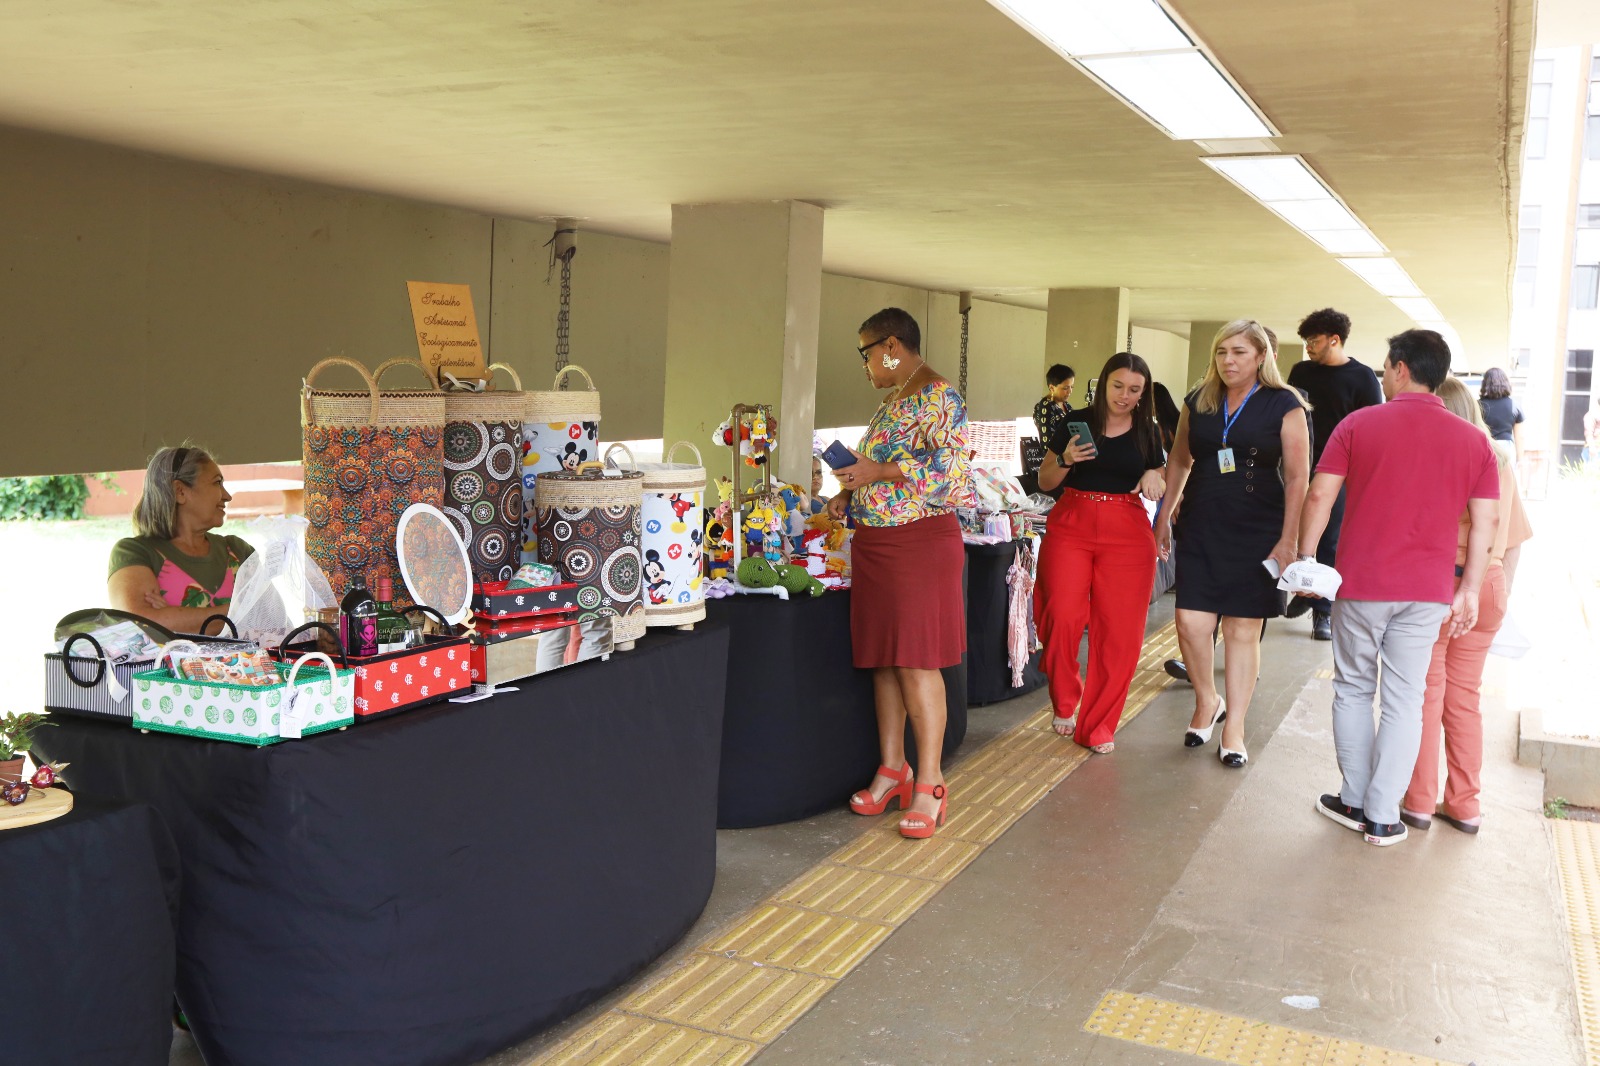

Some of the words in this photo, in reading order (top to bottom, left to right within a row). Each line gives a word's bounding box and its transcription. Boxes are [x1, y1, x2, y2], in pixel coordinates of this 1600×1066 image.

[421, 292, 461, 307] Trabalho
[423, 313, 467, 327] Artesanal
[419, 331, 478, 351] Ecologicamente
